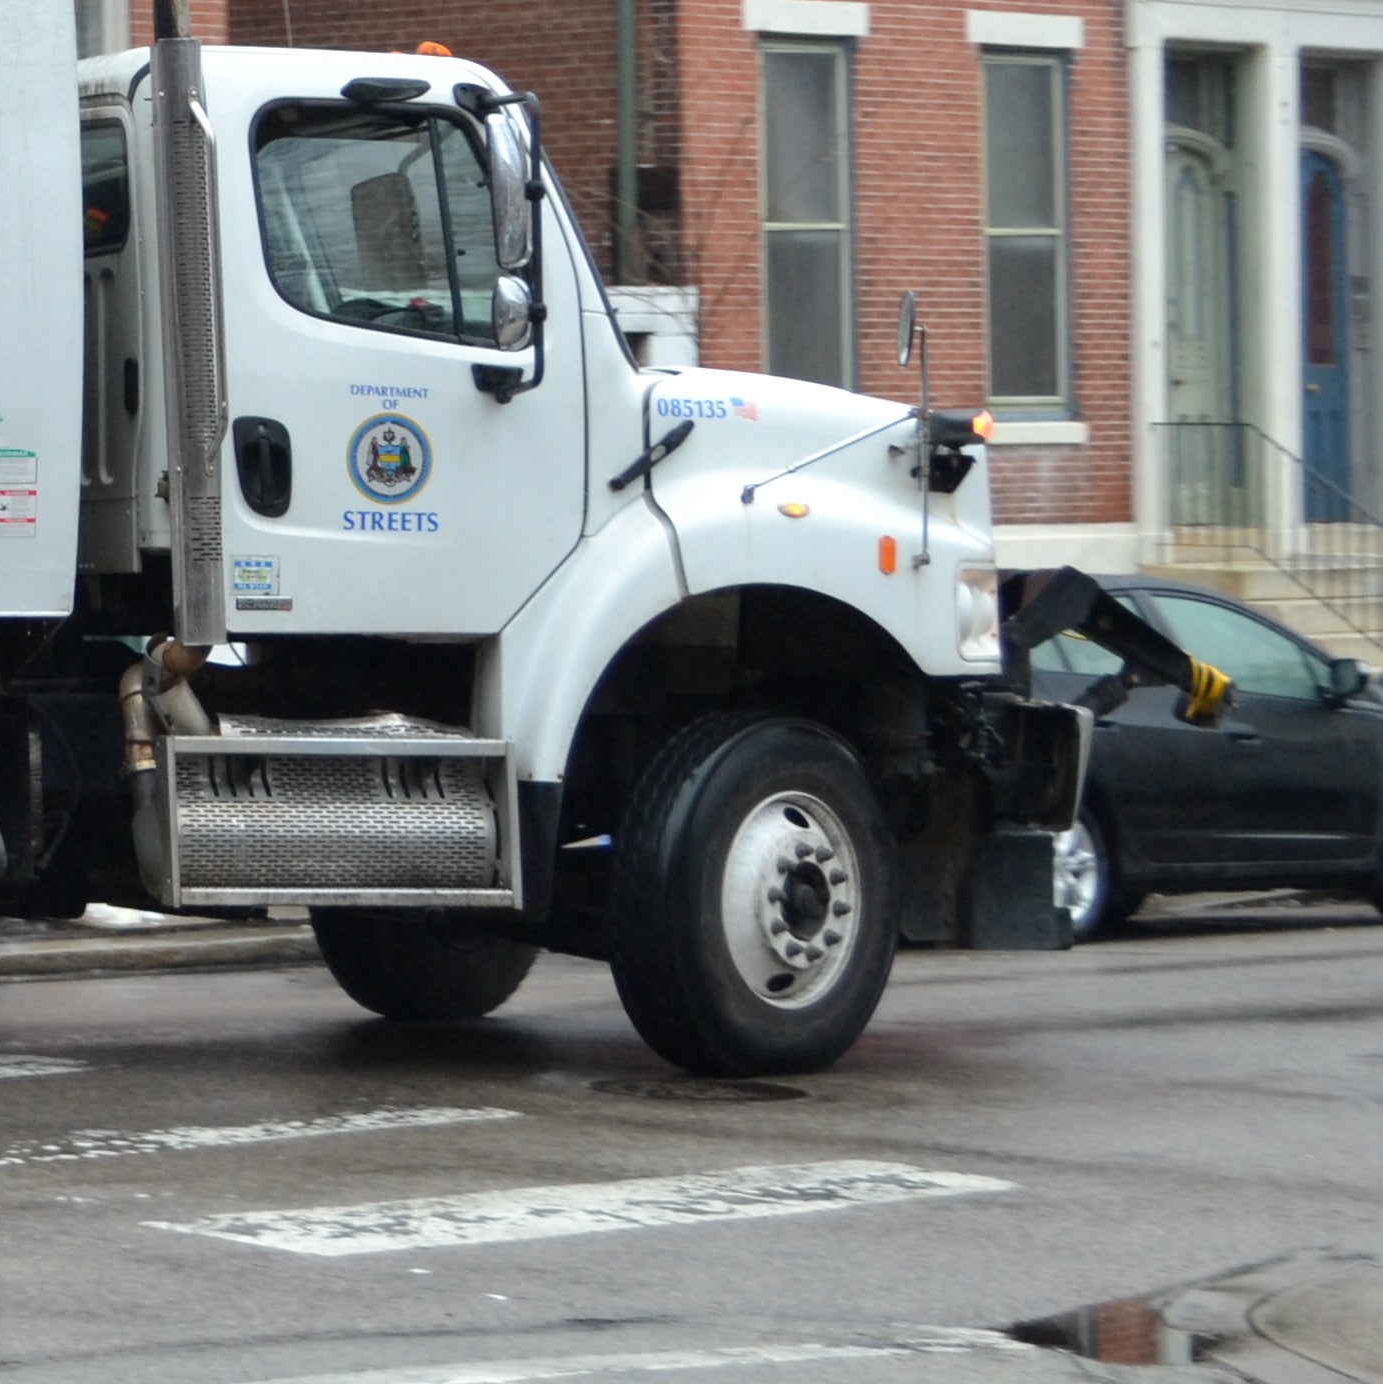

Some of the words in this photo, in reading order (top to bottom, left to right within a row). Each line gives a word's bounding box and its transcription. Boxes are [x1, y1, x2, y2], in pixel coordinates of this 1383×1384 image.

[350, 384, 429, 399] DEPARTMENT
[382, 399, 399, 410] OF
[657, 398, 727, 419] 085135
[343, 510, 439, 533] STREETS
